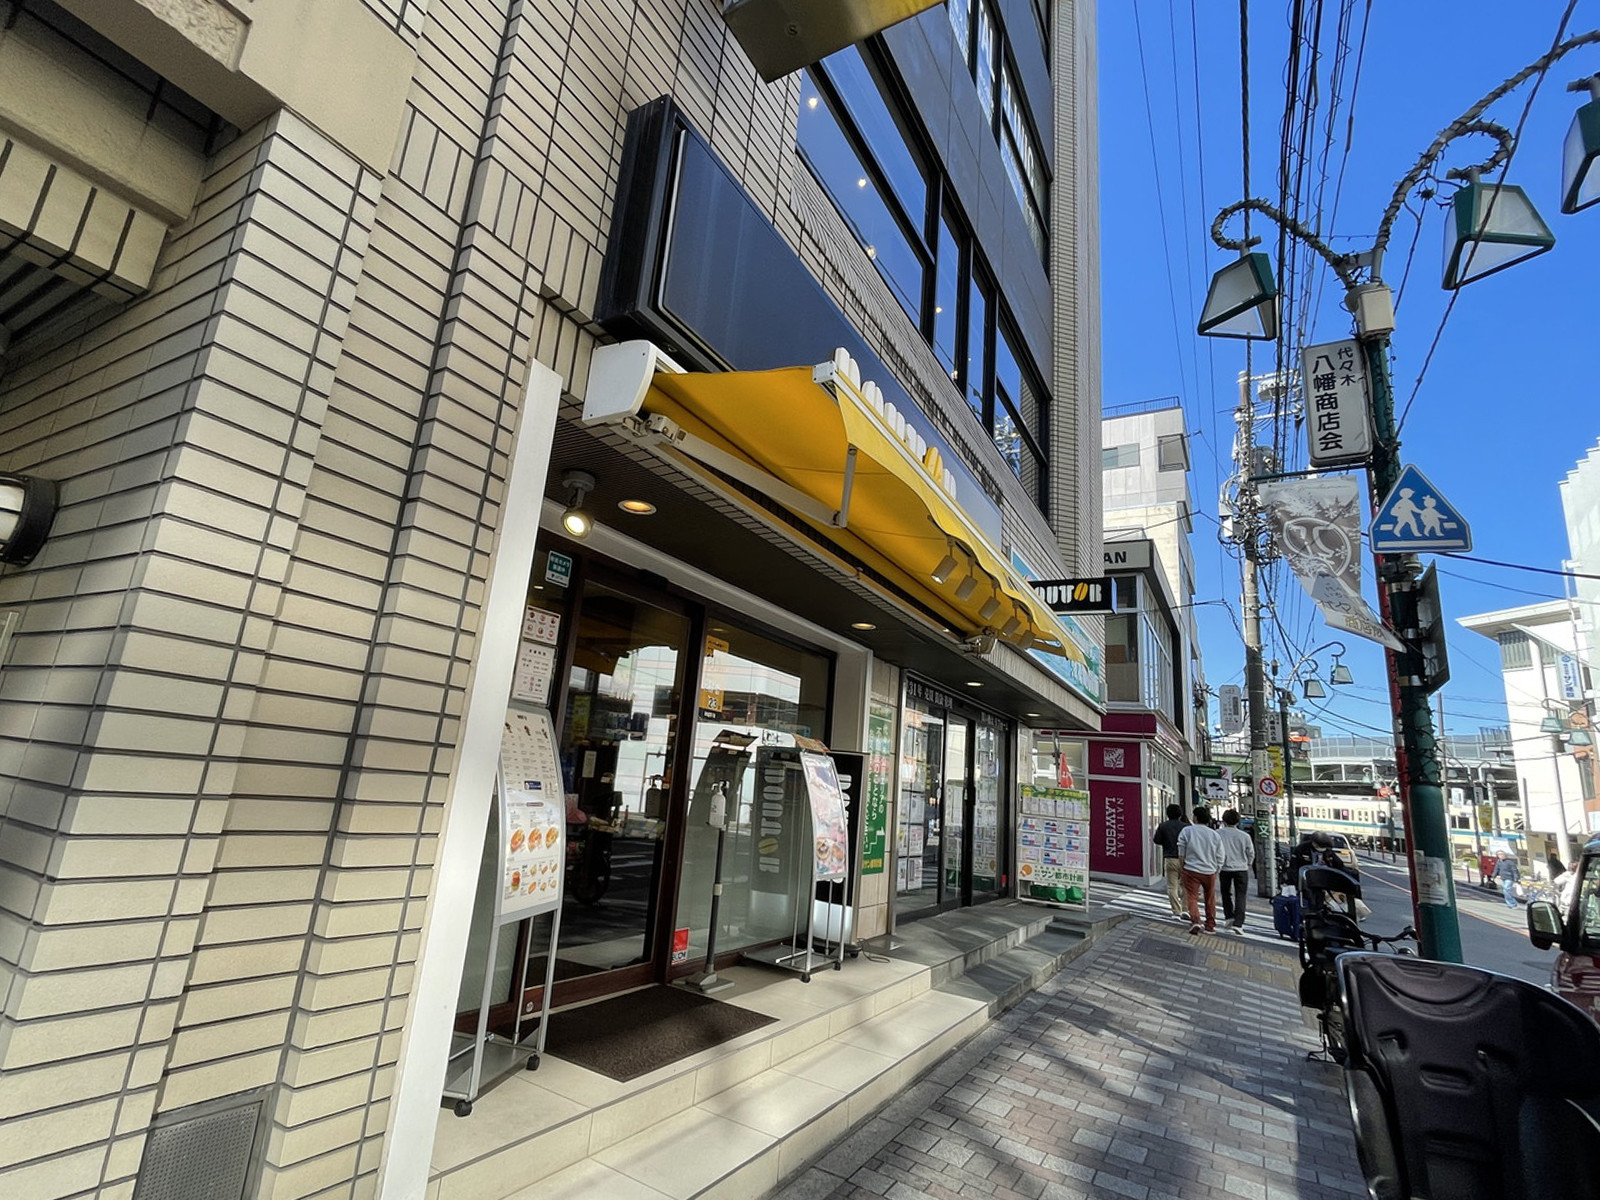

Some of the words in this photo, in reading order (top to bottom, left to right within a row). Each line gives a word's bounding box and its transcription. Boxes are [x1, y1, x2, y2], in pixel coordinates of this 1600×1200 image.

[1337, 347, 1356, 386] 代々木
[1312, 355, 1343, 451] 八幡商店会
[1033, 582, 1102, 604] OUTOR
[1105, 796, 1117, 857] LAWSON
[1116, 797, 1125, 858] NATURAL
